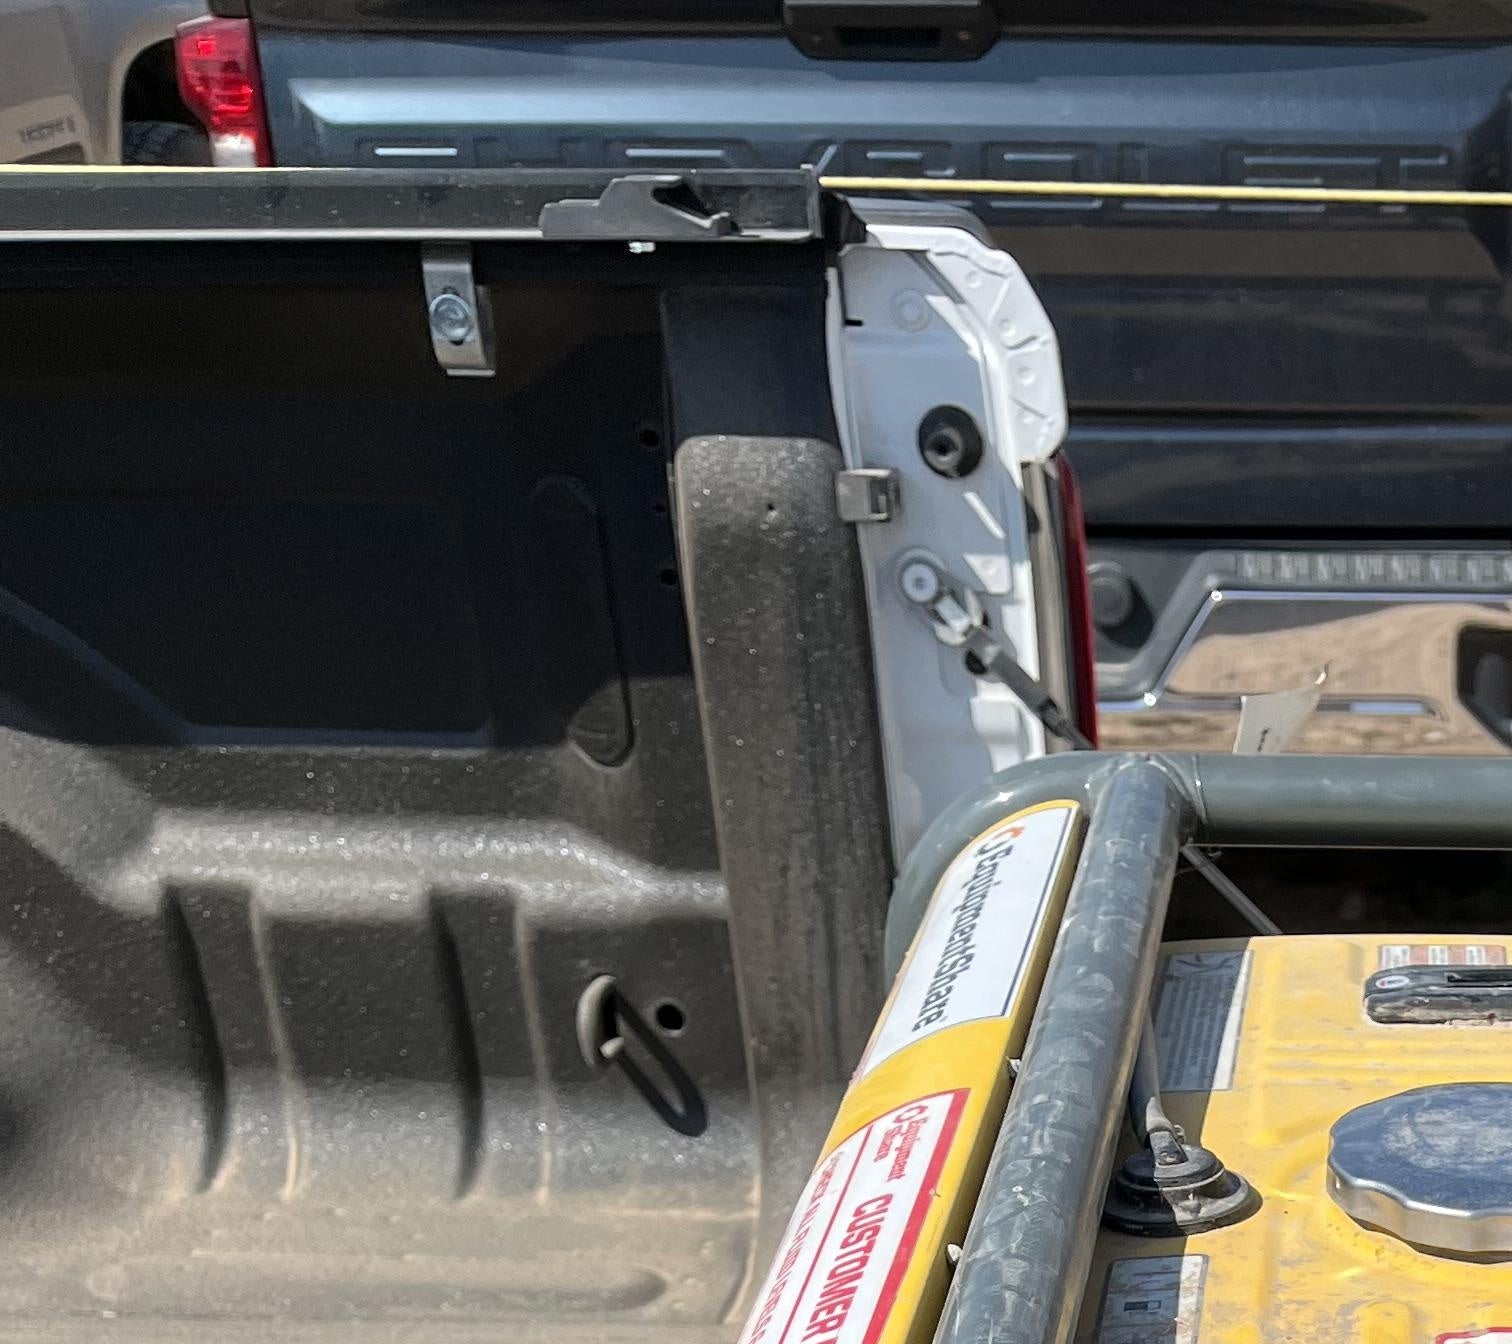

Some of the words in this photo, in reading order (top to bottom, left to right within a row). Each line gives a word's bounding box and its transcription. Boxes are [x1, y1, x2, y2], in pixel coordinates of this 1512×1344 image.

[912, 845, 1014, 1031] EquipmentShare
[887, 1118, 928, 1182] Equipment
[801, 1193, 893, 1342] CUSTOMER
